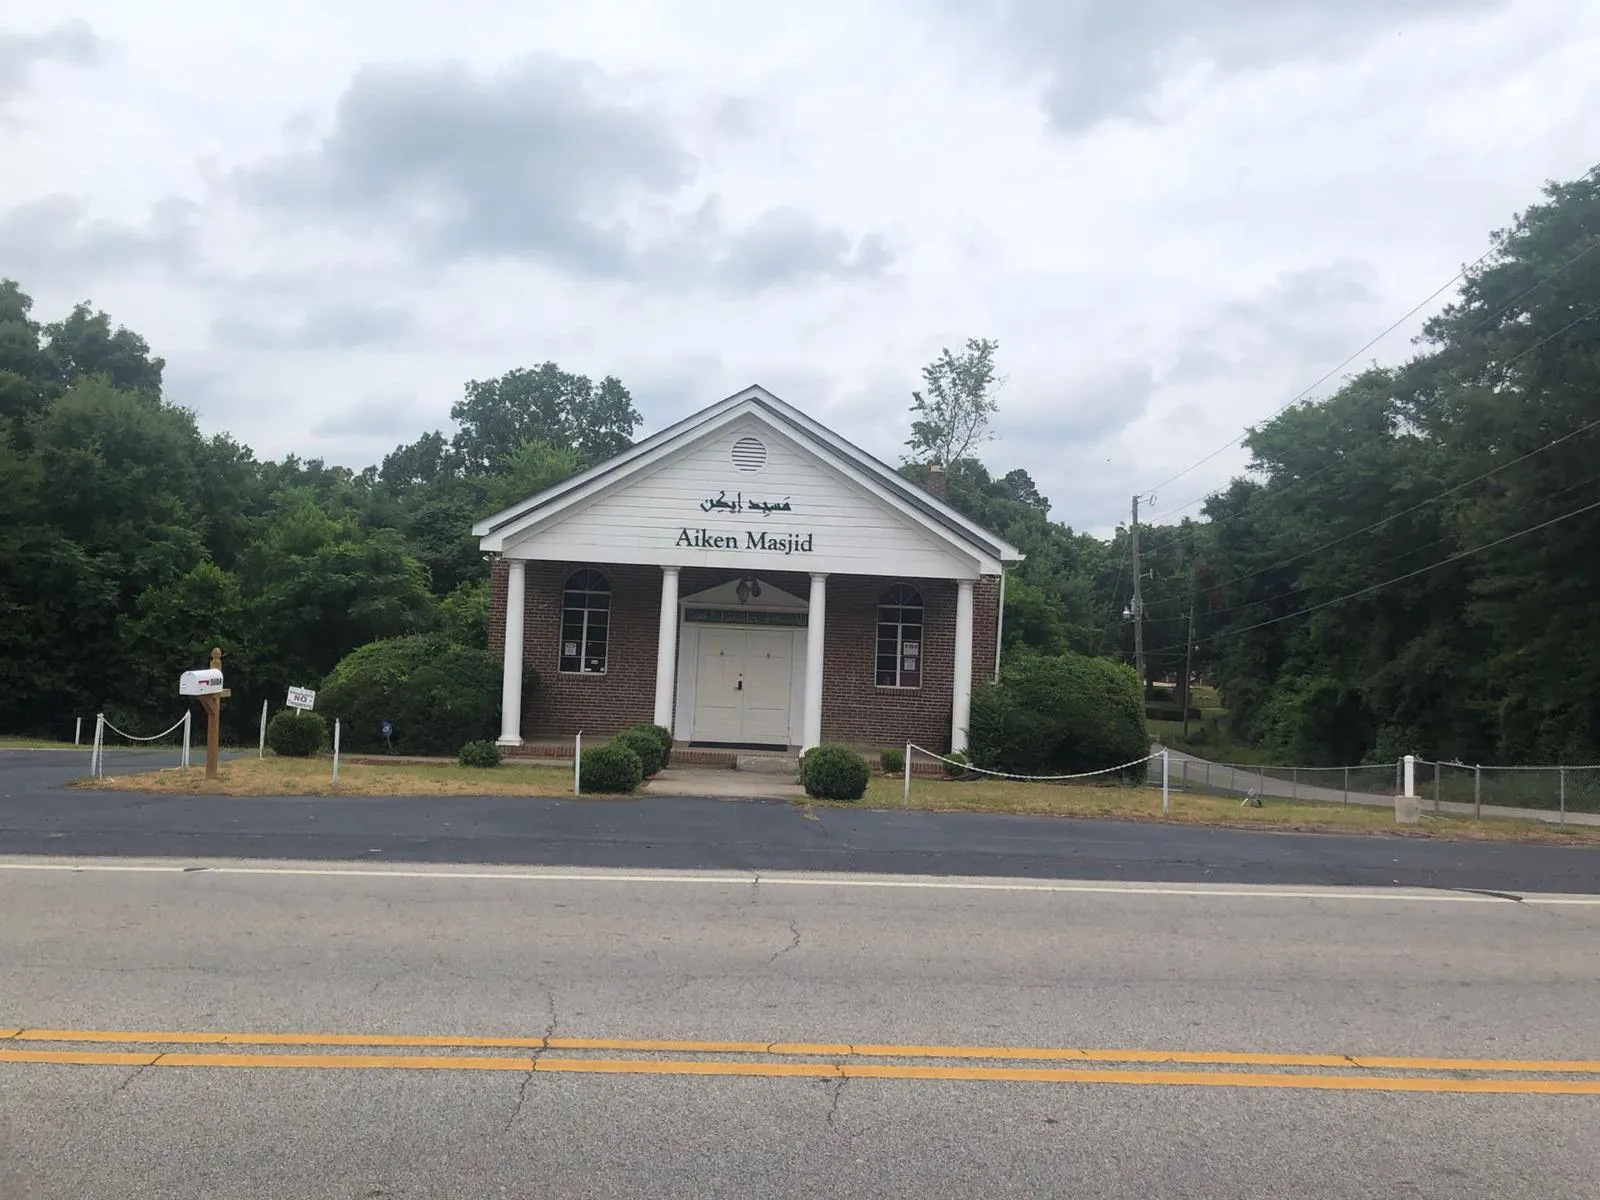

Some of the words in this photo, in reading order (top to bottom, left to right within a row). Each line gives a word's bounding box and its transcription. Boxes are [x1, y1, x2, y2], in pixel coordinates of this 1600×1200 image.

[675, 527, 739, 549] Aiken
[746, 531, 814, 556] Masjid
[294, 695, 307, 703] NO
